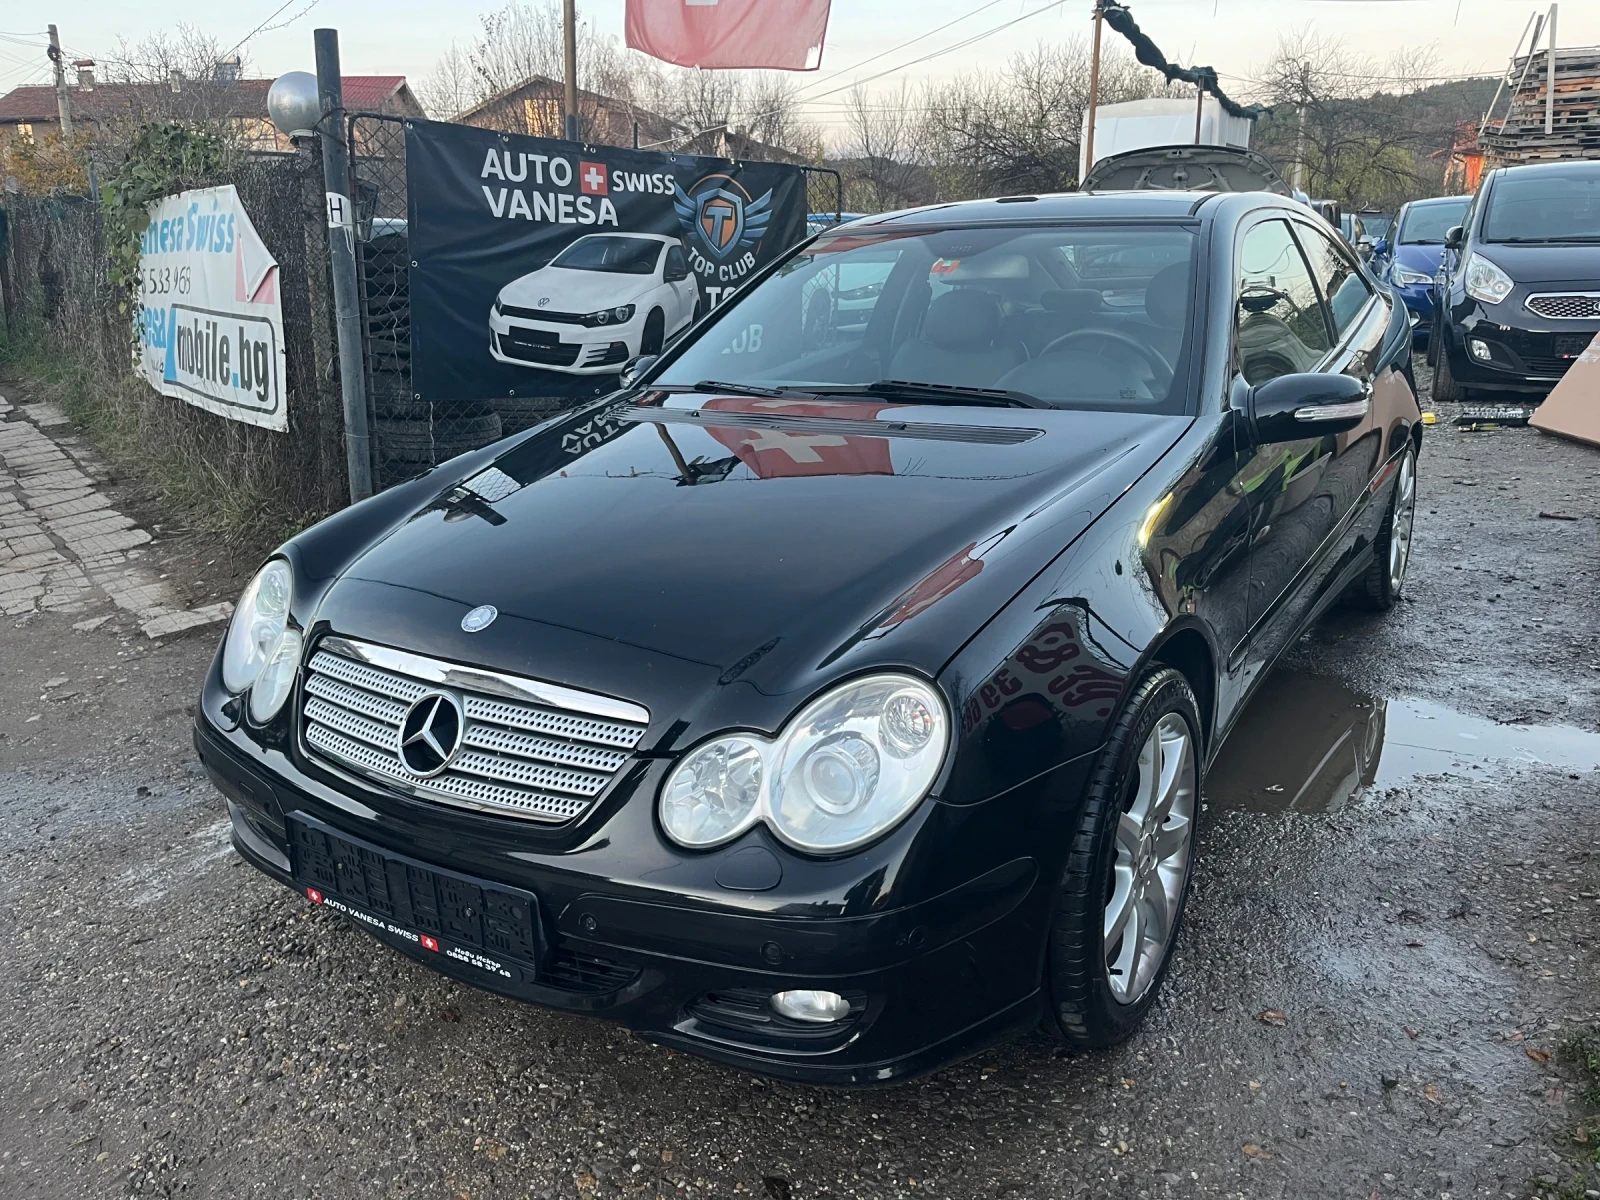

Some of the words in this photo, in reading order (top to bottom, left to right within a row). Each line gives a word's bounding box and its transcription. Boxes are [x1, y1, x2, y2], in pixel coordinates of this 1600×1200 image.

[481, 148, 573, 187] AUTO
[612, 170, 676, 195] SWISS
[481, 185, 619, 227] VANESA
[186, 199, 235, 254] Swiss
[687, 246, 716, 278] TOP
[719, 251, 756, 282] CLUB
[721, 324, 763, 354] UB
[177, 317, 269, 402] mobile.bg
[323, 897, 347, 912] AUTO
[348, 907, 386, 930] VANESA
[387, 924, 419, 942] SWISS
